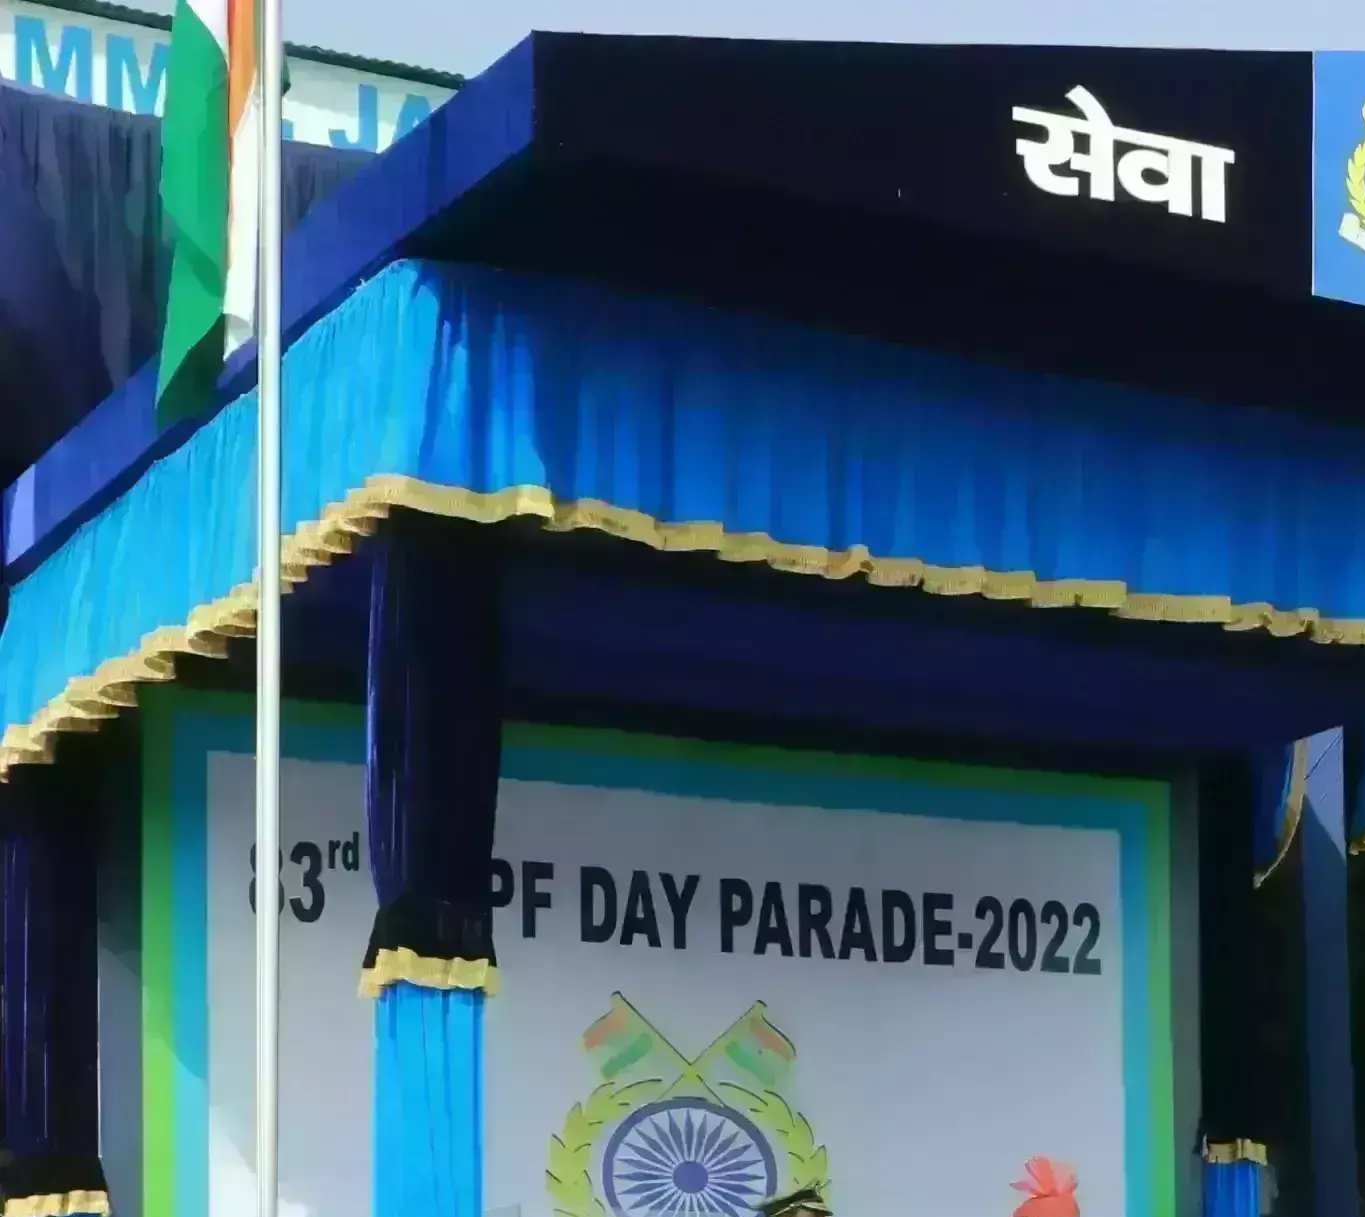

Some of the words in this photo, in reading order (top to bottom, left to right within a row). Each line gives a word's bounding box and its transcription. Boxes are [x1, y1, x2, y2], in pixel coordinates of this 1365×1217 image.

[15, 15, 173, 116] MM
[1012, 85, 1234, 223] सेवा
[492, 859, 554, 938] PF
[580, 866, 700, 949] DAY
[720, 878, 1102, 975] PARADE-2022
